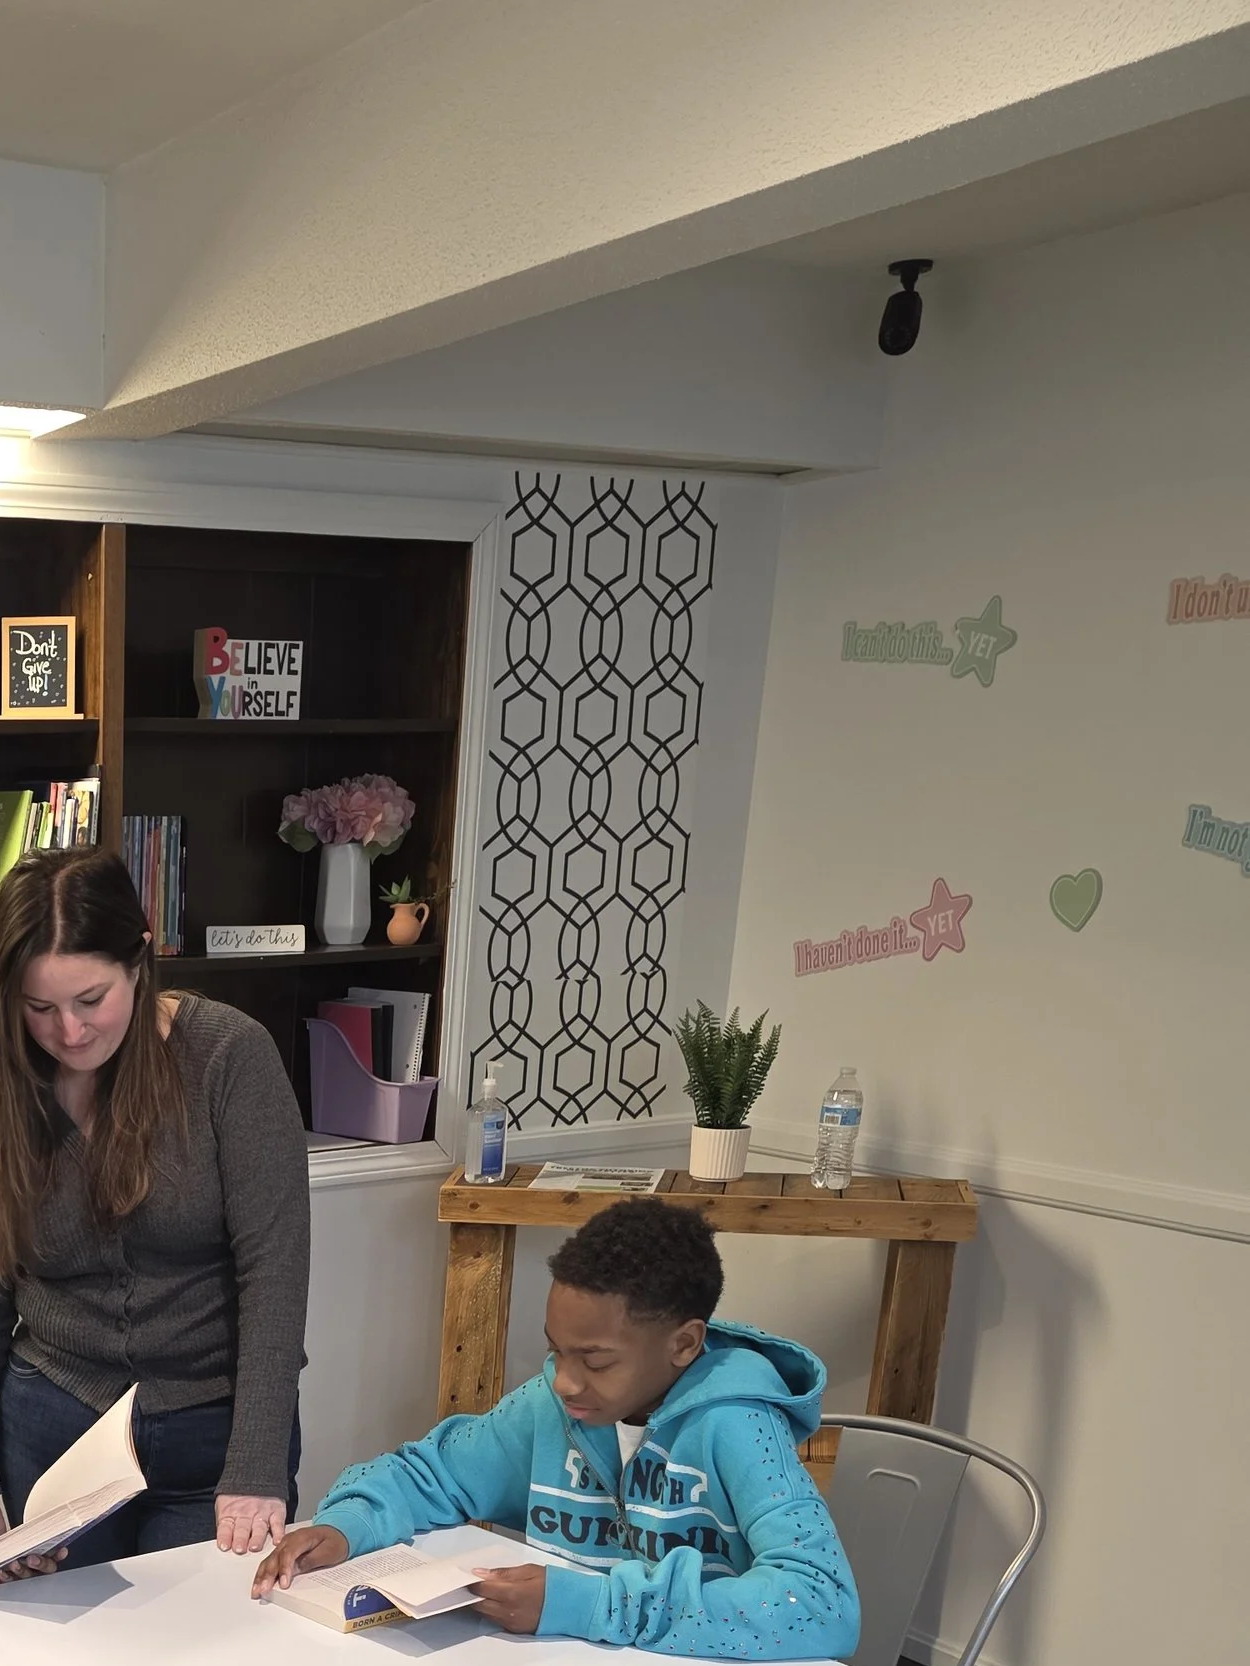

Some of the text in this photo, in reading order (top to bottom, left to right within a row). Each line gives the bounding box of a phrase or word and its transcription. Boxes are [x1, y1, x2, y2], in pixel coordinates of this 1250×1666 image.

[1173, 583, 1182, 619] I
[1184, 579, 1234, 619] don't
[12, 629, 58, 658] Don't
[967, 630, 997, 660] YET
[247, 677, 258, 690] in
[1184, 808, 1250, 858] I'm not
[211, 927, 299, 949] let's do this
[795, 945, 802, 973] I
[805, 934, 852, 971] haven't
[856, 930, 889, 959] done
[926, 909, 954, 937] YET
[352, 1617, 375, 1629] BORN
